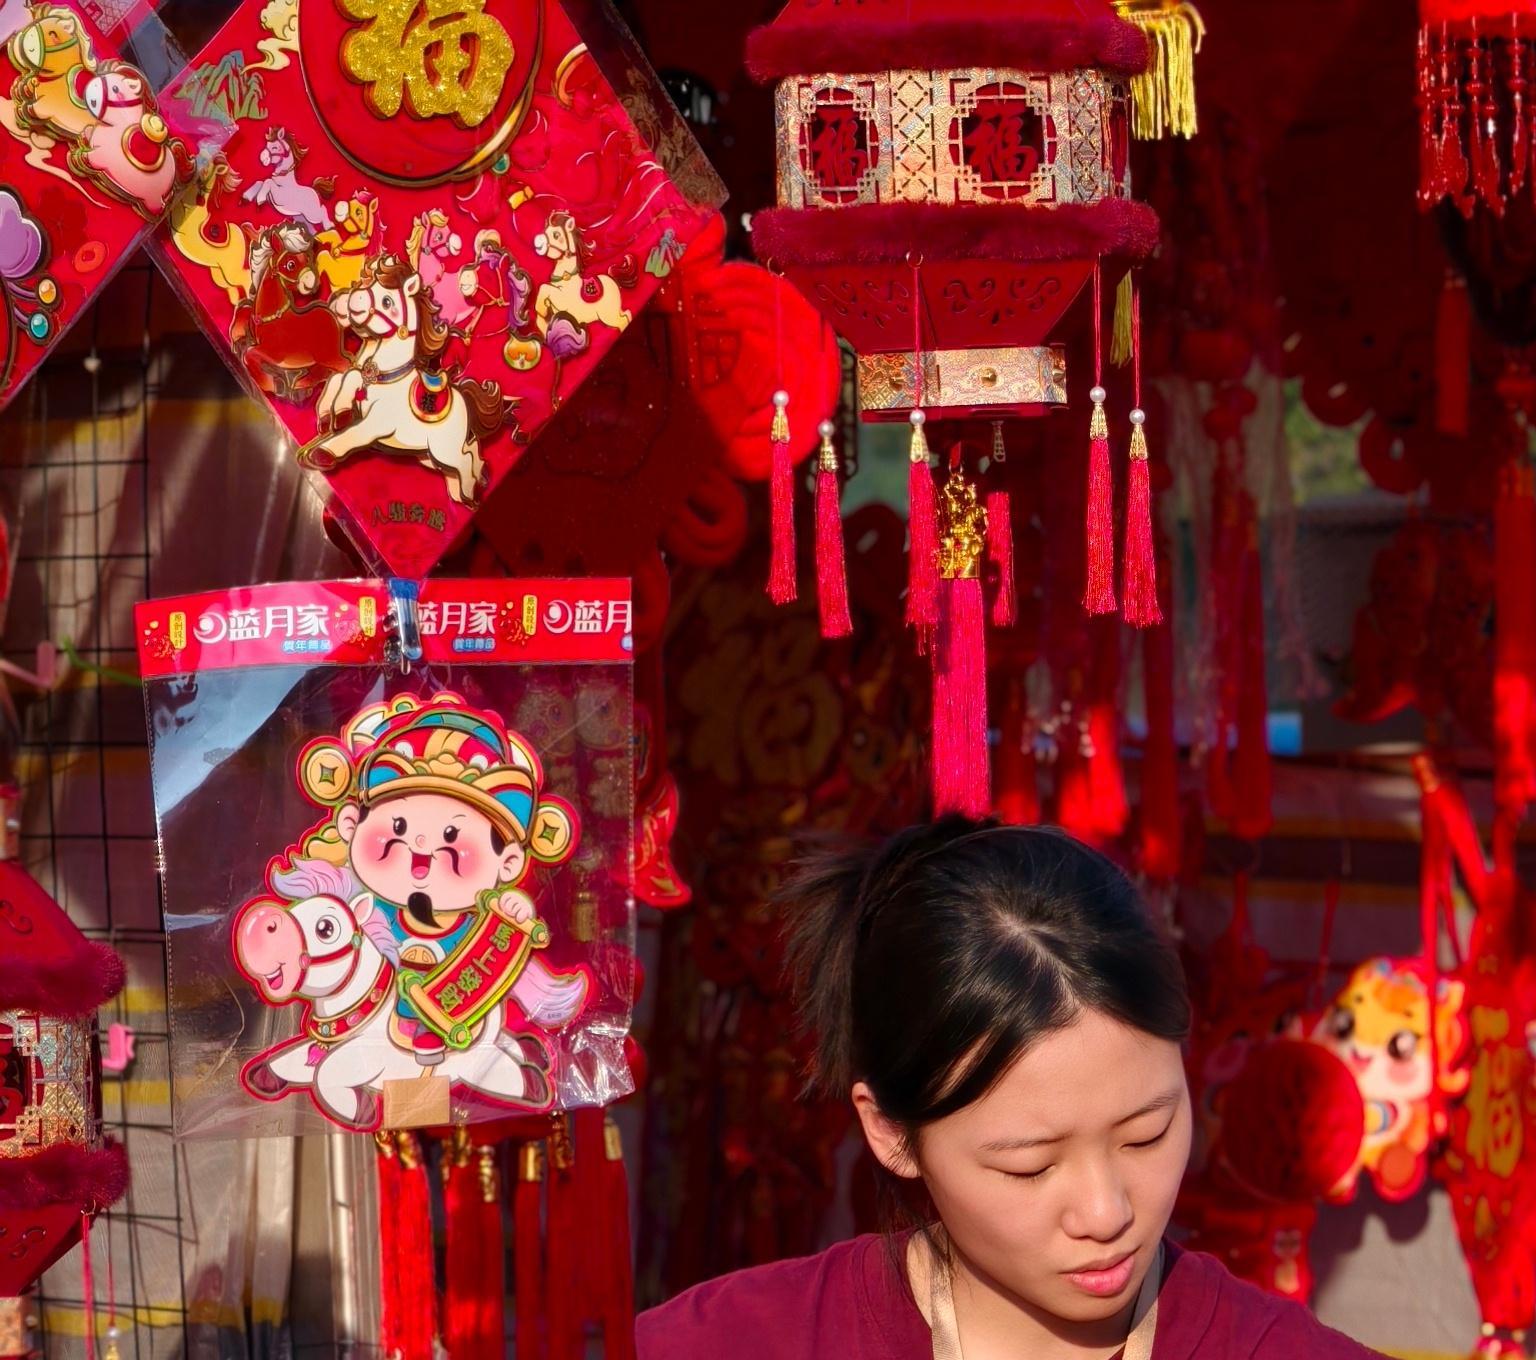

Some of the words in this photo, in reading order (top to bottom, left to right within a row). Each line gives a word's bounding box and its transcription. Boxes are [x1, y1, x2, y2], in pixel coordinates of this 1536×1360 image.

[812, 105, 867, 188] 福
[963, 98, 1039, 182] 福
[228, 603, 330, 642] 蓝月家
